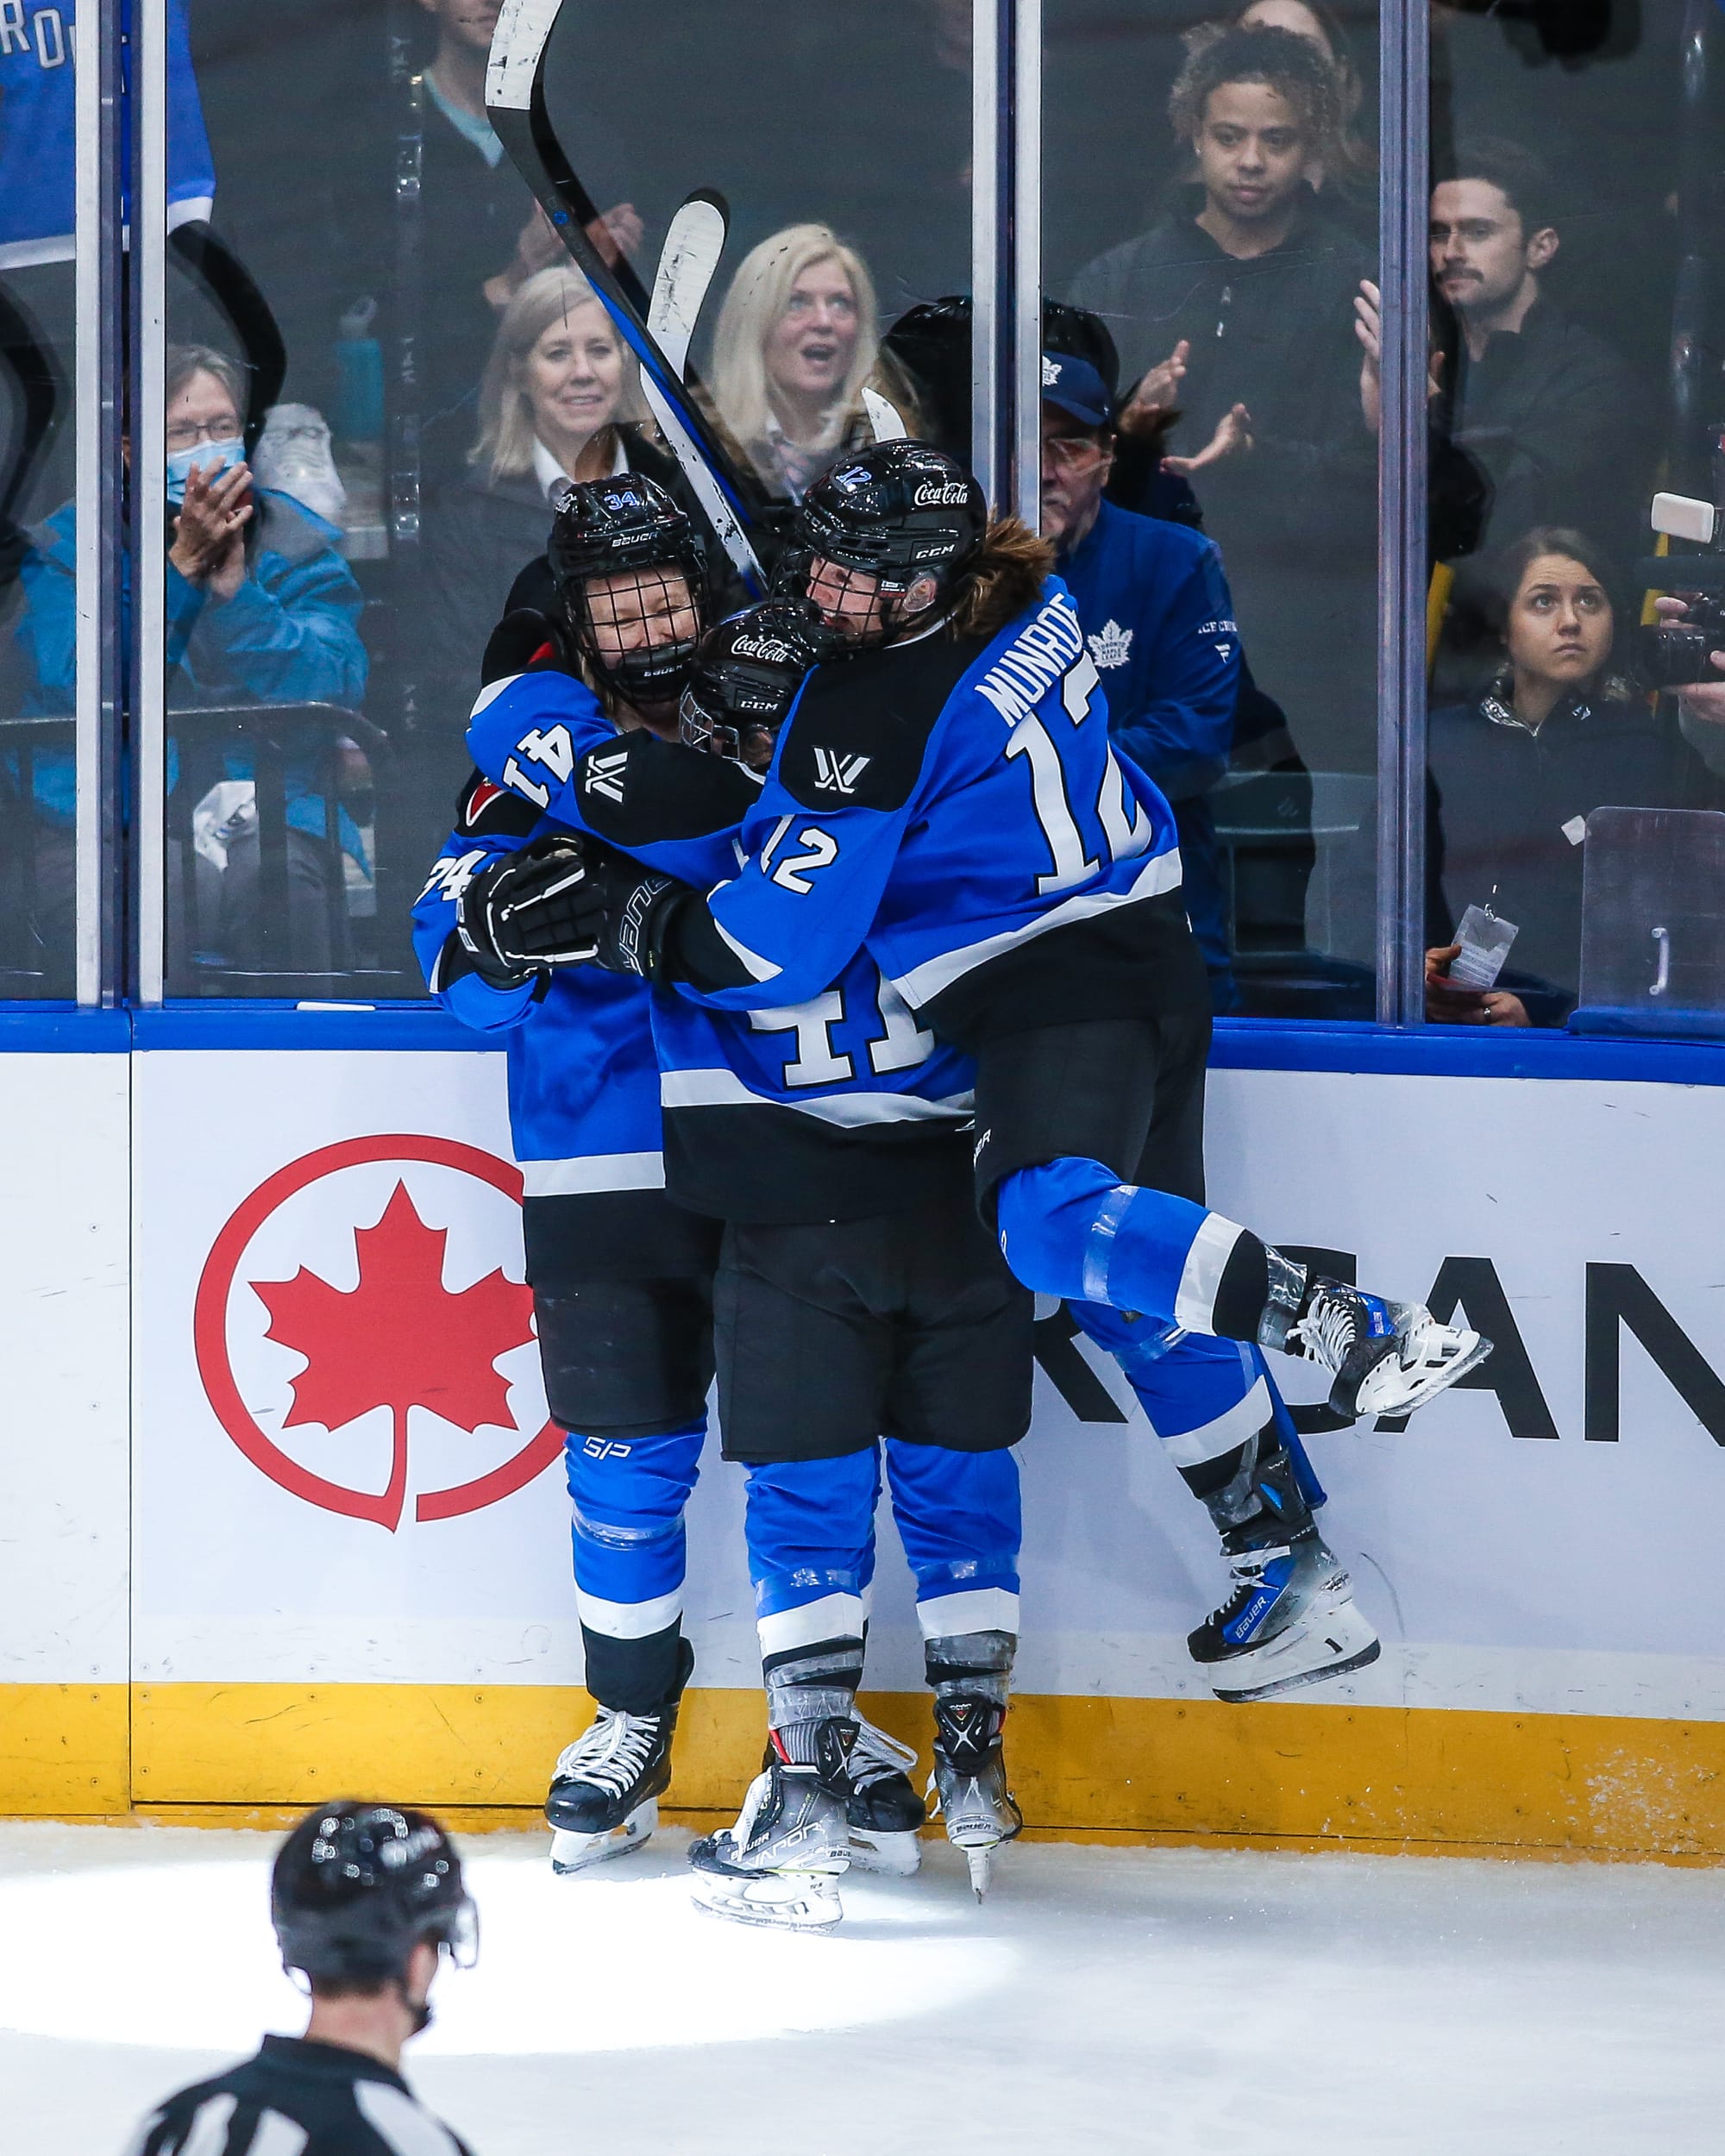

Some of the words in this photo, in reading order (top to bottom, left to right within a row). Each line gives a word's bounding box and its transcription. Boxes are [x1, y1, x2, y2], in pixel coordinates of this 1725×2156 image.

[604, 491, 640, 511] 34
[915, 543, 956, 561] CCM
[740, 699, 780, 711] CCM
[504, 723, 574, 809] 41
[1005, 649, 1153, 896] 12
[761, 814, 839, 894] 12
[731, 1831, 770, 1862] BUER
